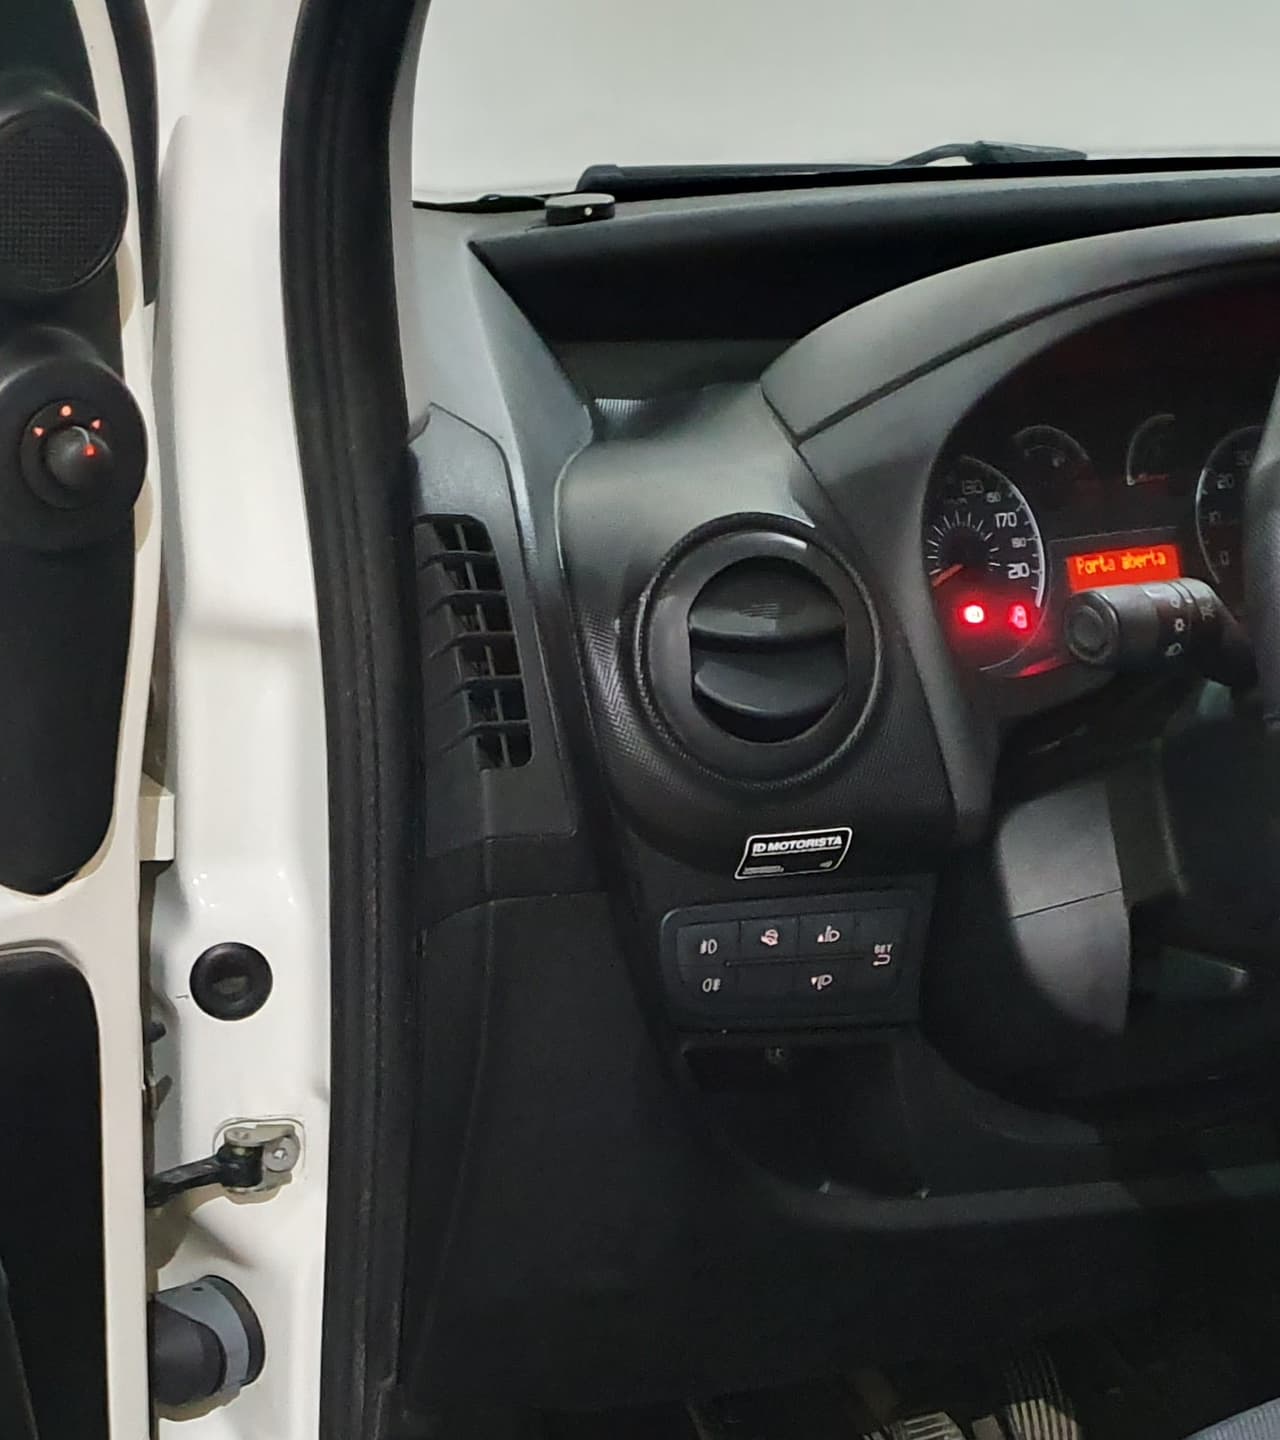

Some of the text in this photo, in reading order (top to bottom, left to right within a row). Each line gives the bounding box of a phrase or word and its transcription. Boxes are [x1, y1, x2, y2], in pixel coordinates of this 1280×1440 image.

[994, 511, 1018, 528] 170
[1075, 549, 1167, 576] Porta aberta
[767, 836, 843, 853] MOTORISTA
